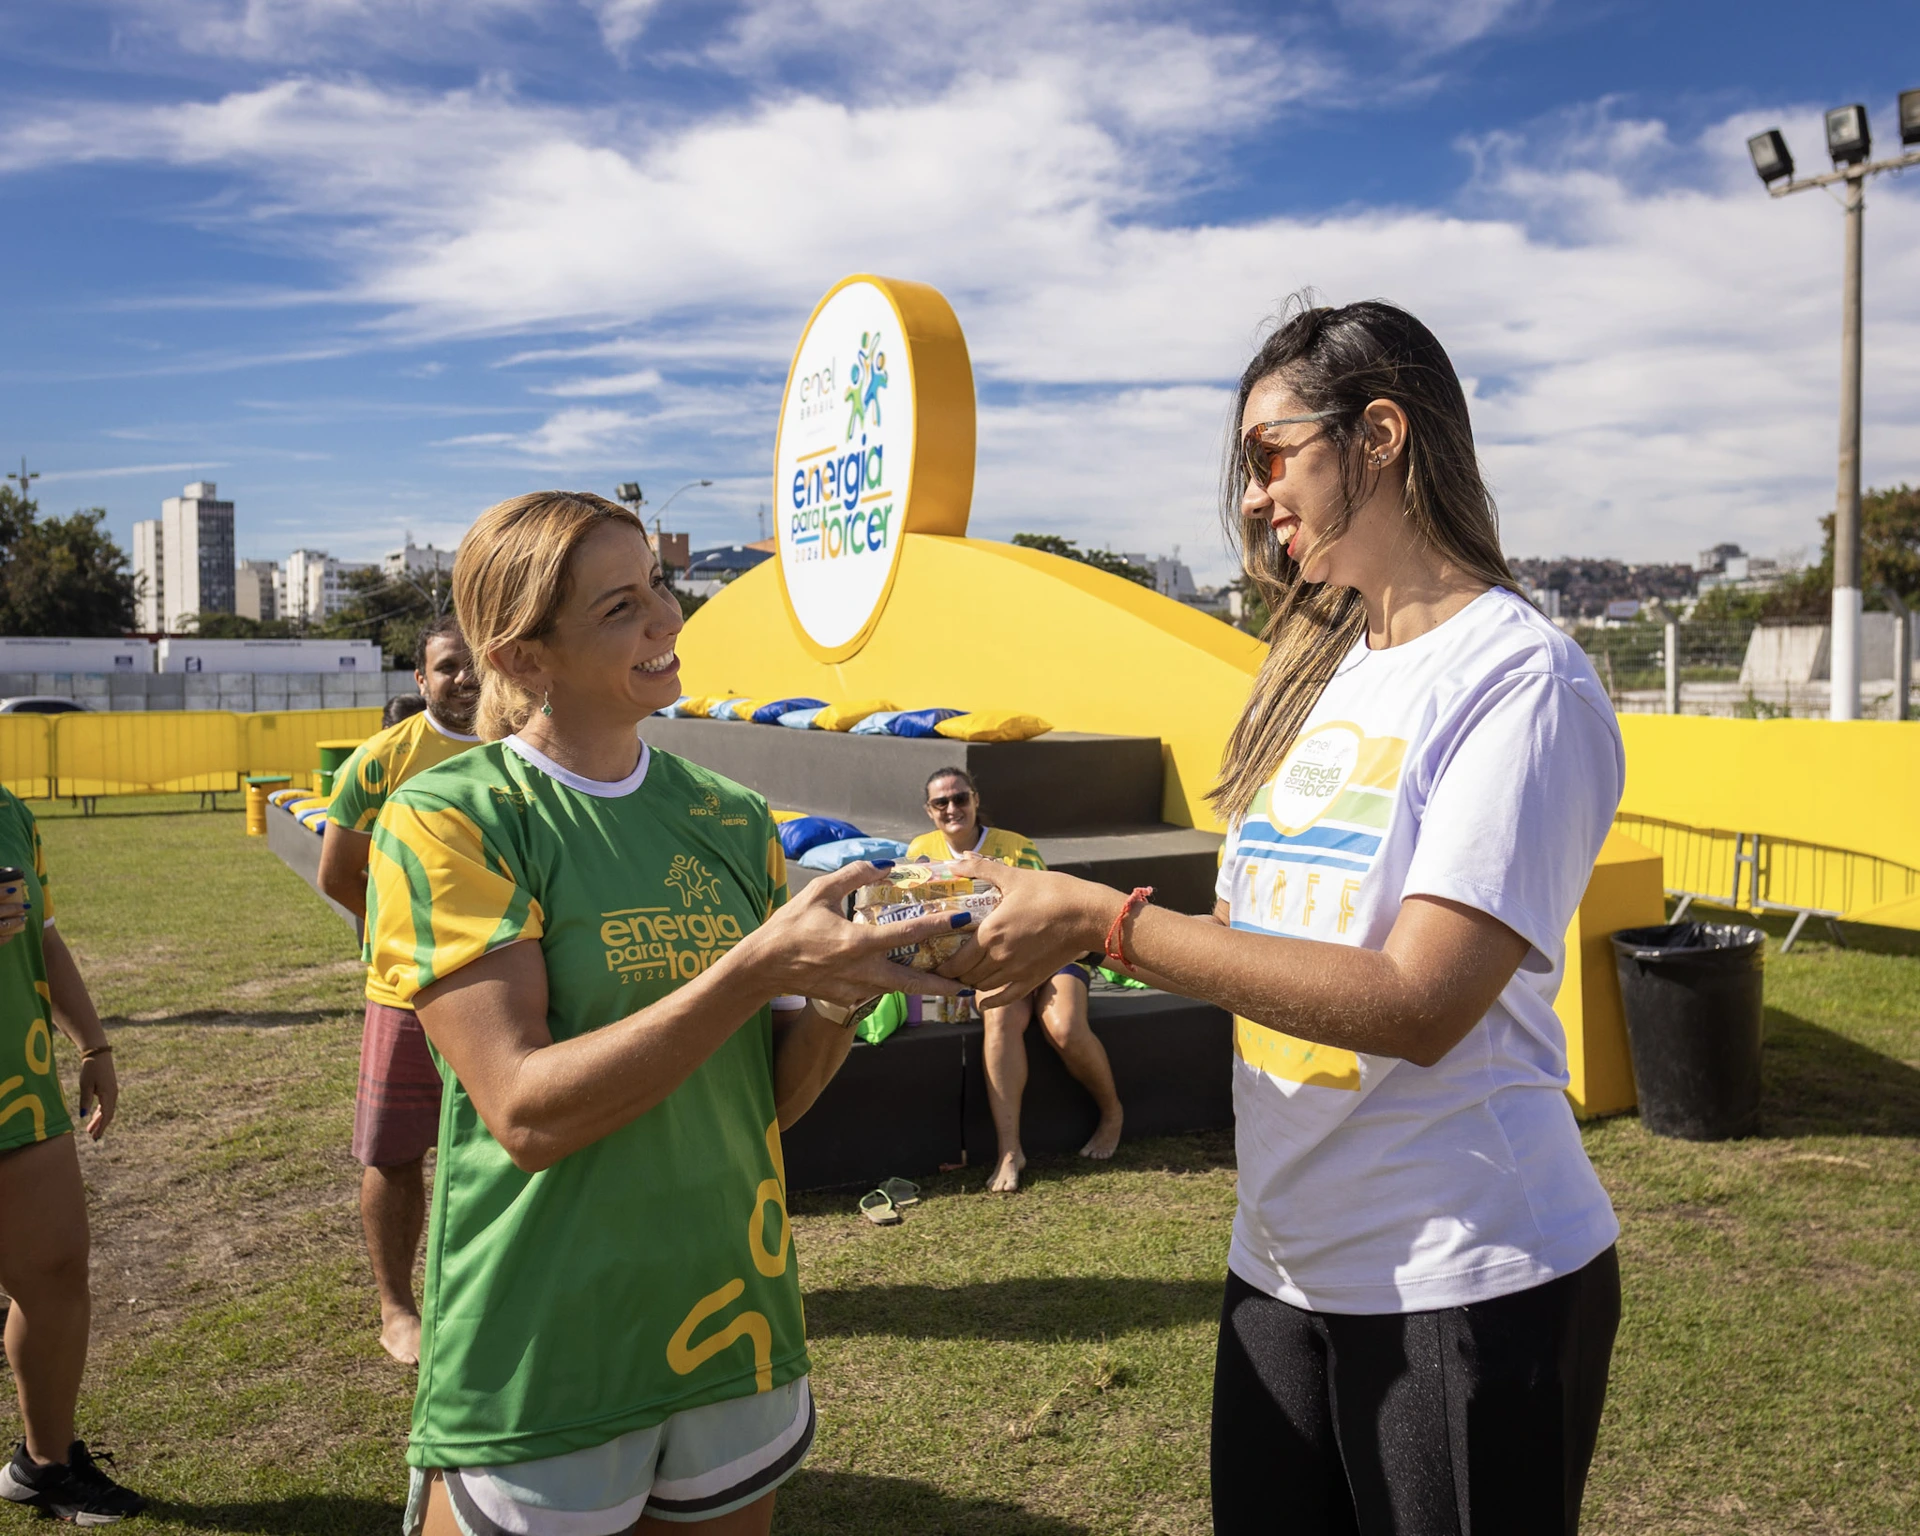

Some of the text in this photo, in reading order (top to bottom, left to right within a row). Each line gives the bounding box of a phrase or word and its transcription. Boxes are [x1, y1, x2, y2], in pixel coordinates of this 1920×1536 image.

[800, 356, 836, 403] enel
[792, 433, 883, 511] energia
[791, 503, 893, 560] para torcer
[1306, 739, 1333, 751] enel
[689, 808, 707, 816] RIO
[721, 818, 748, 826] NEIRO
[1246, 864, 1361, 935] TAFF
[600, 905, 744, 949] energia
[878, 904, 922, 926] NUTRY
[605, 942, 665, 972] para
[620, 968, 665, 985] 2026
